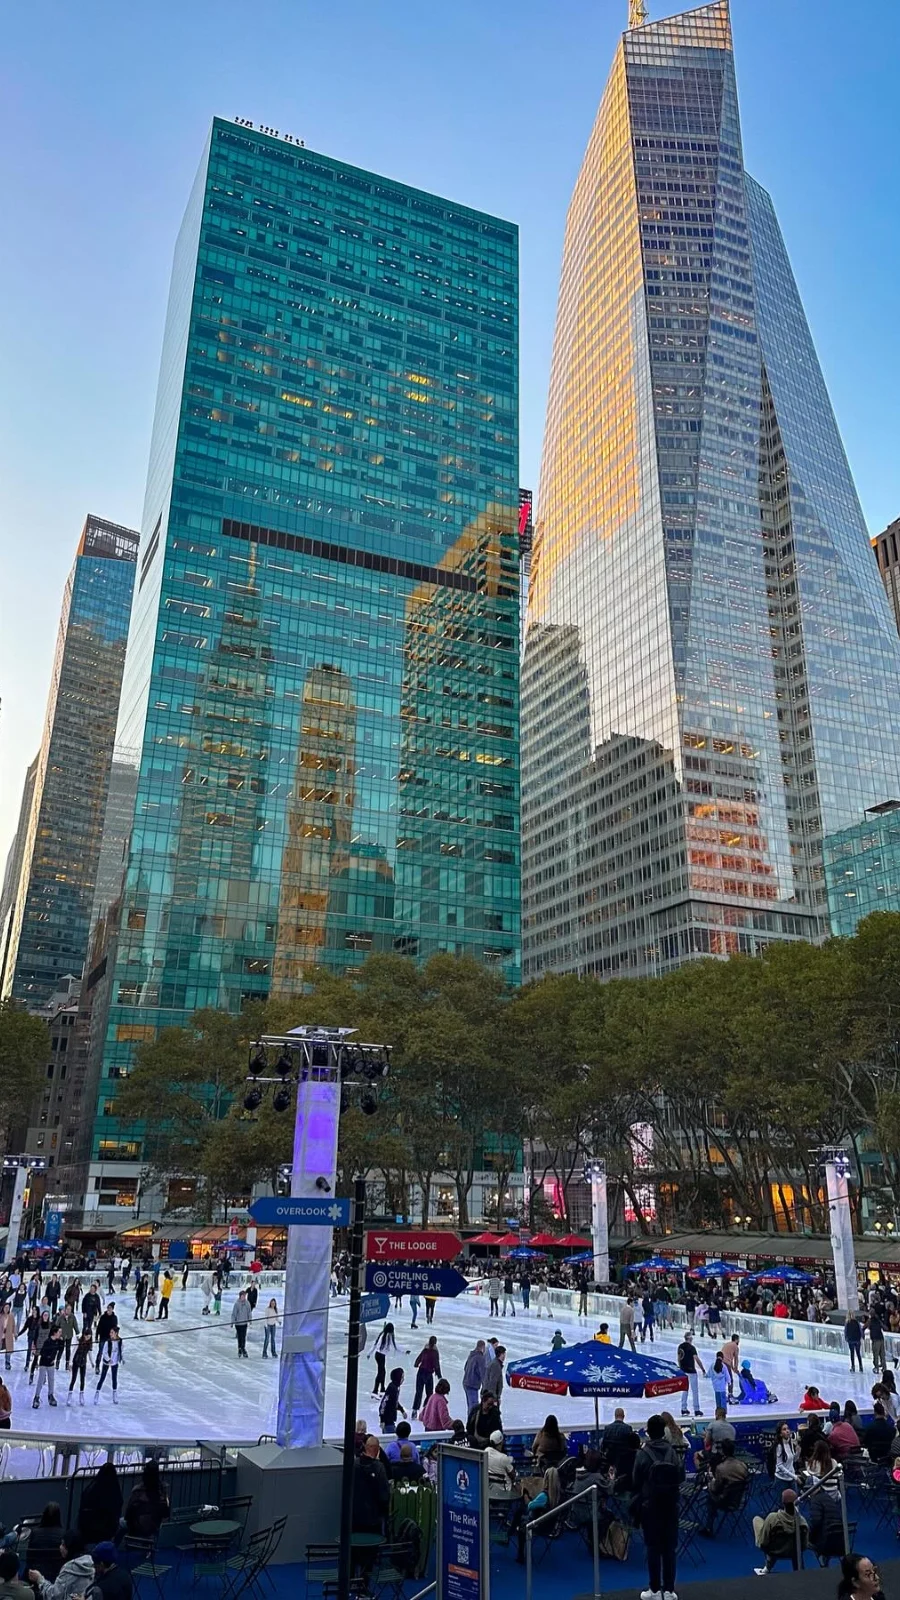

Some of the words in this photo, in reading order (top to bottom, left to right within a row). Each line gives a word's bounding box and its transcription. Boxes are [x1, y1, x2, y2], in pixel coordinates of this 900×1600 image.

[276, 1206, 327, 1216] OVERLOOK
[389, 1241, 406, 1250] THE
[408, 1241, 437, 1251] LODGE
[388, 1271, 428, 1282] CURLING
[422, 1282, 442, 1291] BAR
[449, 1510, 461, 1523] The
[462, 1513, 477, 1527] Rink
